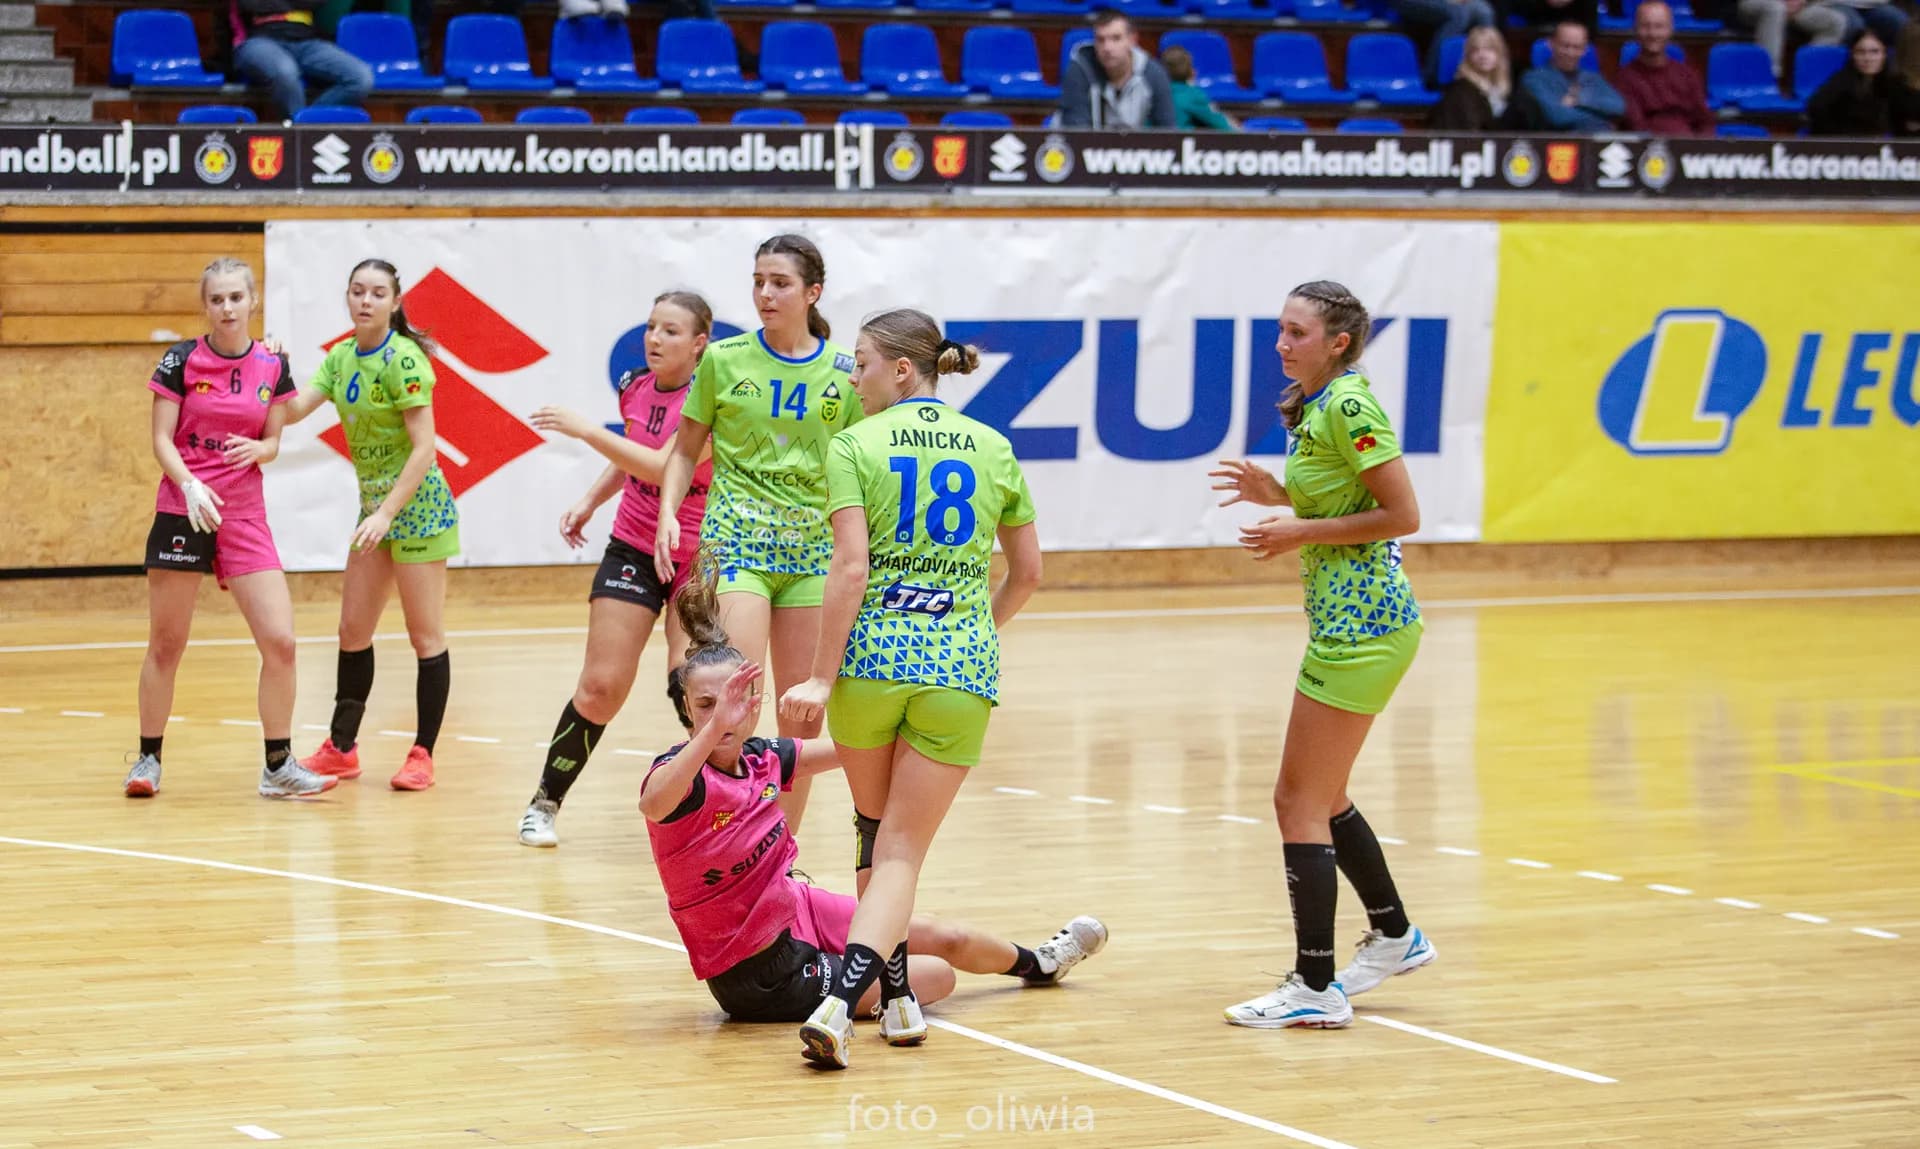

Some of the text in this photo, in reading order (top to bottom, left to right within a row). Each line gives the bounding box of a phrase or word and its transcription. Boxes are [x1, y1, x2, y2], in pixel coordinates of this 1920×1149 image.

[1082, 138, 1496, 188] www.koronahandball.pl
[1681, 143, 1920, 181] www.koronaha
[230, 367, 242, 394] 6
[346, 371, 361, 404] 6
[769, 379, 808, 421] 14
[646, 405, 668, 436] 18
[889, 428, 977, 452] JANICKA
[888, 456, 977, 547] 18
